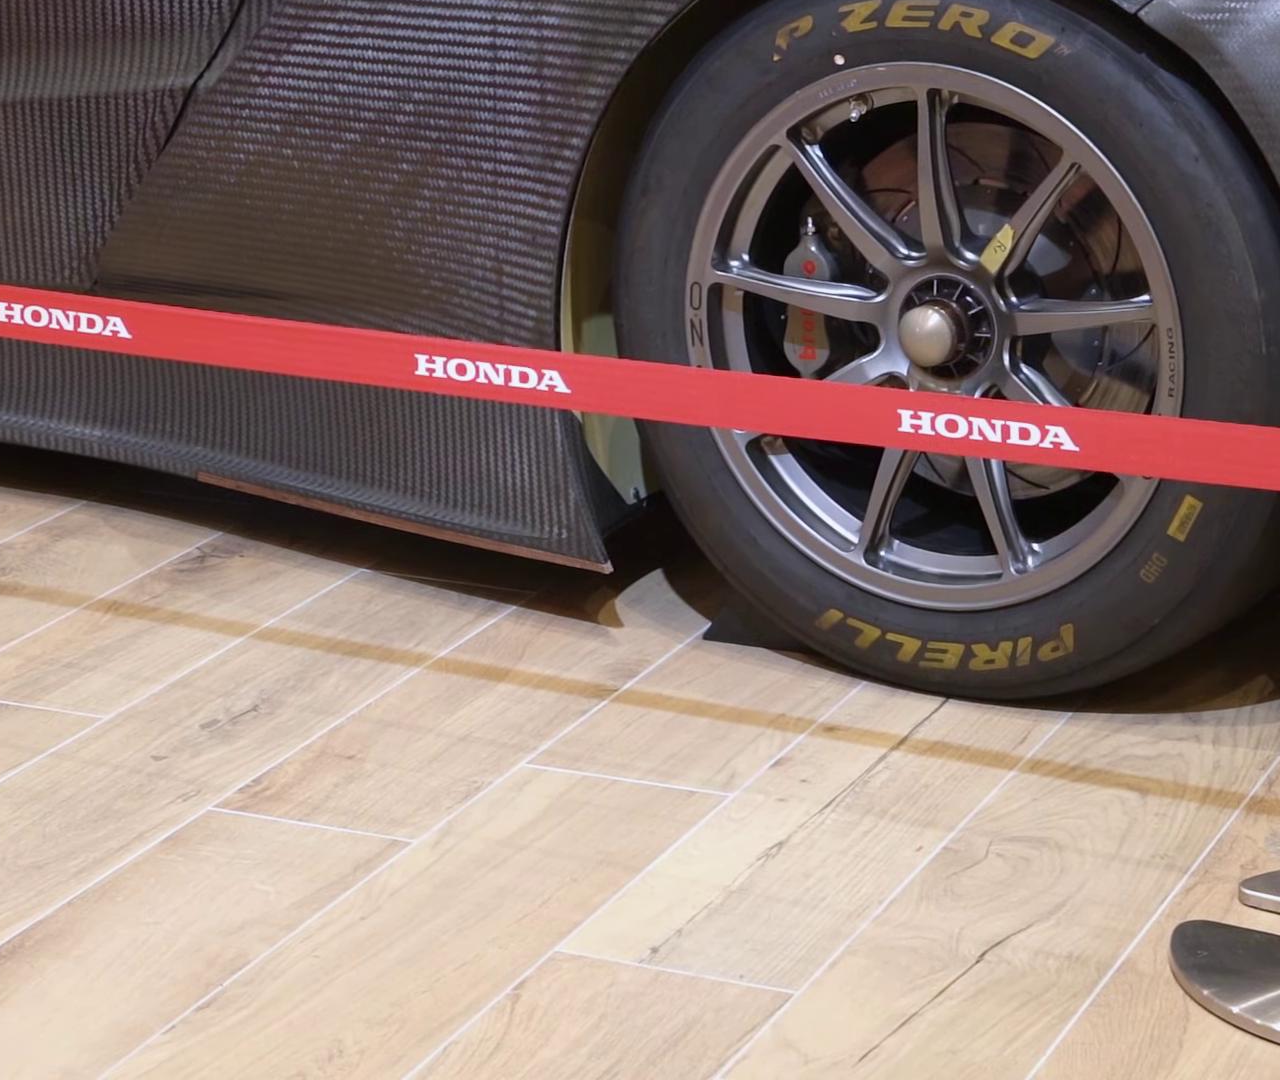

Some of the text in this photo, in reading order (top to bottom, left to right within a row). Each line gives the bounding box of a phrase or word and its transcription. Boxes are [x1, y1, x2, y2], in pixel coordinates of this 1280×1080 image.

[837, 0, 1056, 60] ZERO
[414, 353, 572, 394] HONDA
[1166, 327, 1176, 398] RACING
[896, 408, 1081, 452] HONDA
[816, 608, 1075, 672] PIRELLI
